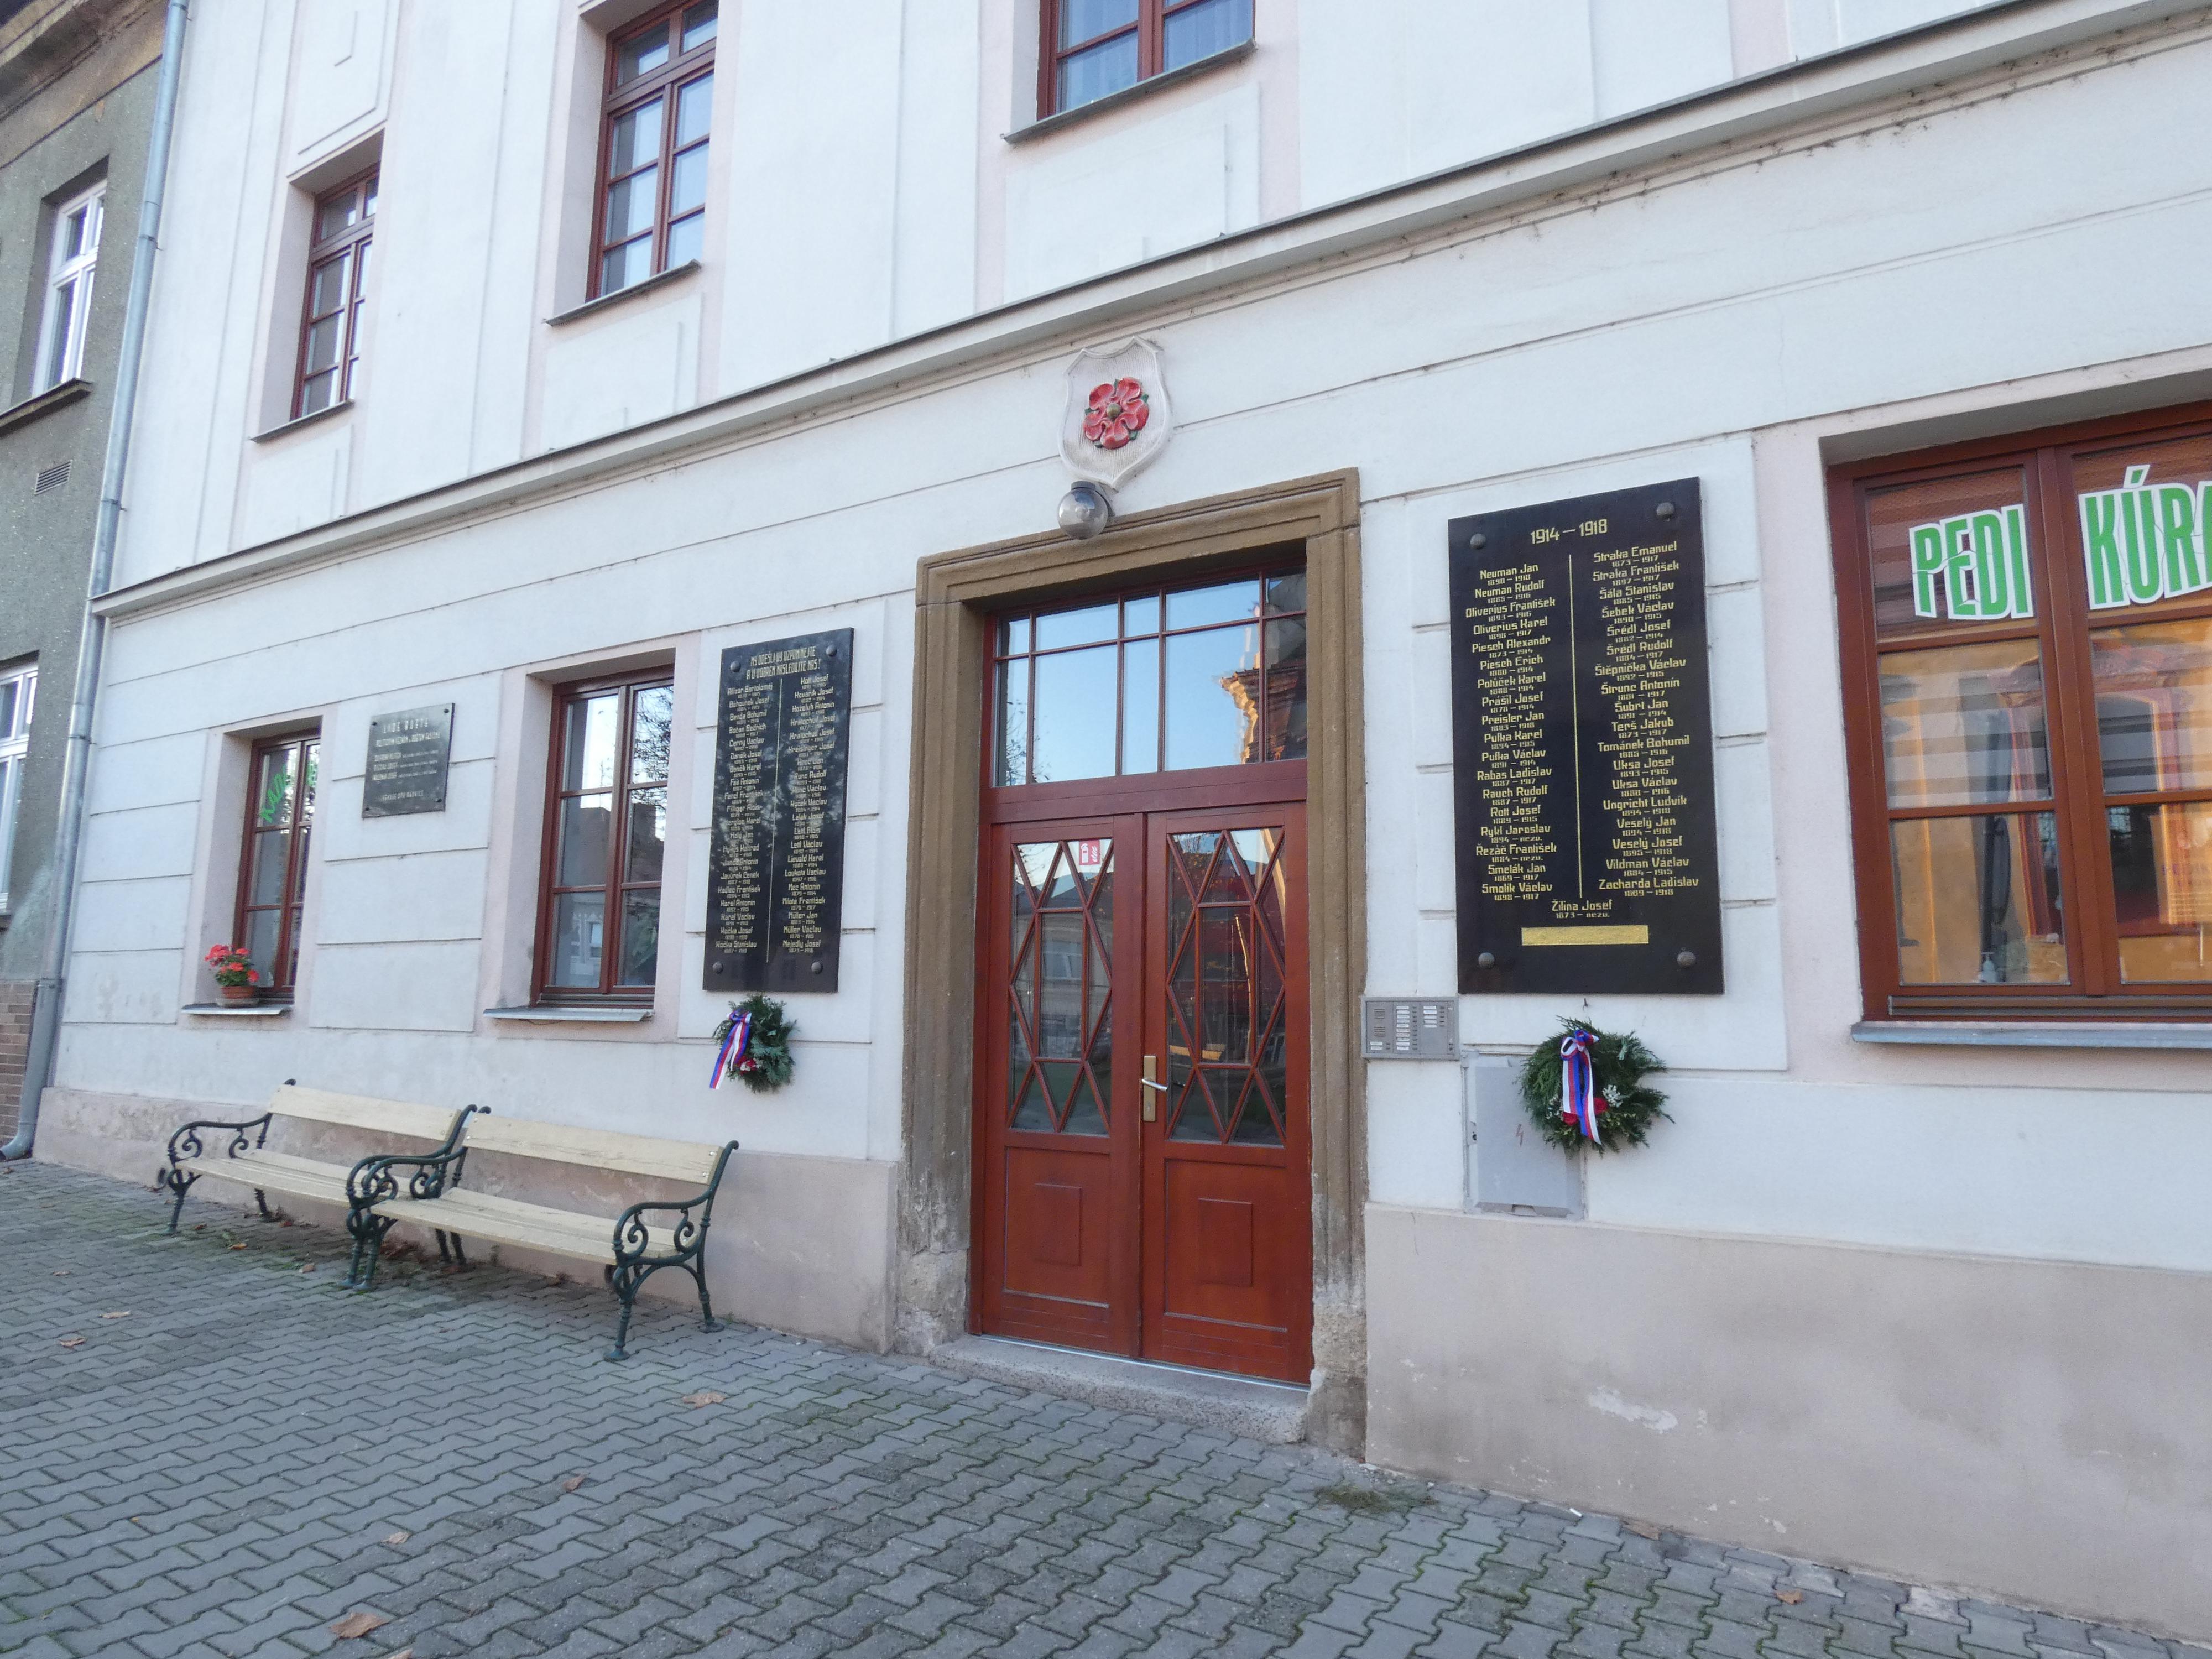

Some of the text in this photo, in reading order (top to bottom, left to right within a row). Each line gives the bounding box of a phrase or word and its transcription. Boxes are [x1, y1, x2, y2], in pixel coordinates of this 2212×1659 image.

[1531, 519, 1607, 544] 1914 1918
[1909, 464, 2212, 620] PEDI KÚR
[1594, 541, 1677, 562] Straka Emanuel
[1480, 564, 1538, 580] Neuman Jan
[1593, 560, 1679, 581] Straka František
[1475, 580, 1545, 598] Neuman Rudolf
[1626, 582, 1674, 596] Stanislav
[1466, 597, 1555, 618] Oliverius František
[1601, 601, 1674, 618] Šebek Václav
[1474, 616, 1548, 635] Oliverius Karel
[1640, 619, 1671, 632] Josef
[1472, 635, 1551, 653] Piesch Alexandr
[1640, 639, 1673, 651] Rudolf
[1480, 655, 1543, 670] Piesch Erich
[1650, 658, 1686, 670] Václav
[1519, 672, 1546, 684] Karel
[1640, 677, 1679, 690] Antonín
[818, 686, 833, 695] Josef
[1482, 691, 1543, 707] Prášil Josef
[1648, 699, 1668, 709] Jan
[1482, 712, 1544, 725] Preisler Jan
[1611, 717, 1674, 732] Terš Jakub
[1515, 729, 1542, 740] Karel
[1598, 735, 1690, 752] Tománek Bohumil
[1513, 748, 1546, 759] Václav
[1613, 756, 1674, 770] Uksa Josef
[1477, 767, 1552, 780] Rabas Ladislav
[1612, 776, 1677, 789] Uksa Václav
[1483, 785, 1548, 799] Rauch Rudolf
[1512, 805, 1541, 816] Josef
[1656, 816, 1676, 826] Jan
[1506, 824, 1551, 835] Jaroslav
[1510, 842, 1557, 854] František
[1652, 836, 1682, 848] Josef
[1527, 863, 1546, 873] Jan
[1606, 857, 1689, 869] Vildman Václav
[1519, 882, 1552, 892] Václav
[1599, 876, 1698, 889] Zacharda Ladislav
[1582, 899, 1613, 910] Josef
